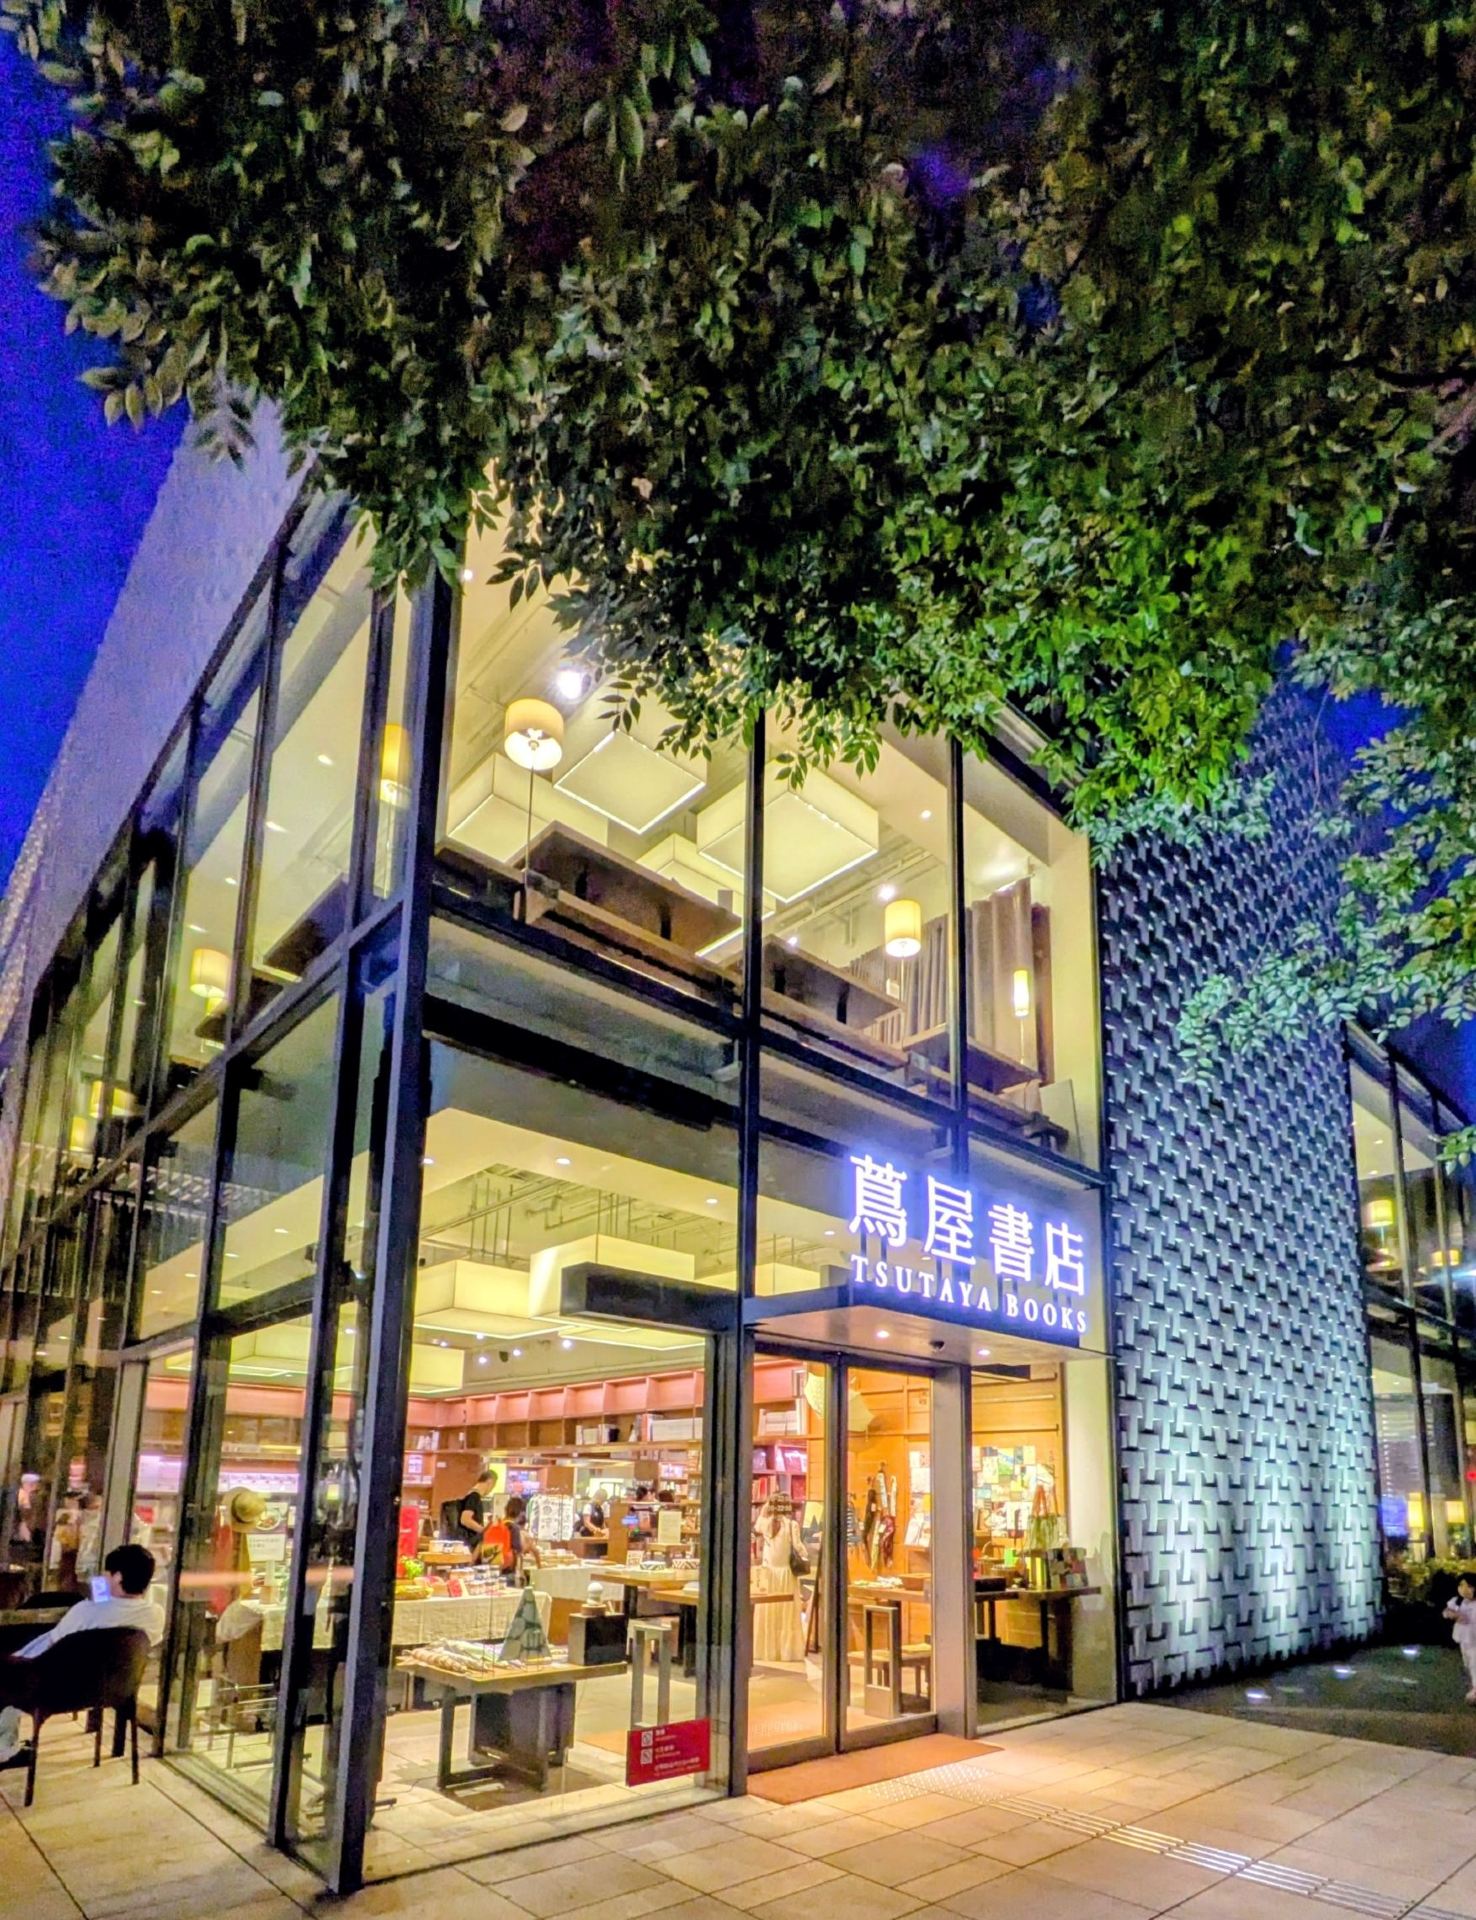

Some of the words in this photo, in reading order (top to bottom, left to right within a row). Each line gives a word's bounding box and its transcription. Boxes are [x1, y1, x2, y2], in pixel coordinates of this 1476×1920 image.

[849, 1154, 1085, 1296] 蔦屋書店
[851, 1254, 992, 1312] TSUTAYA
[1006, 1293, 1087, 1333] BOOKS
